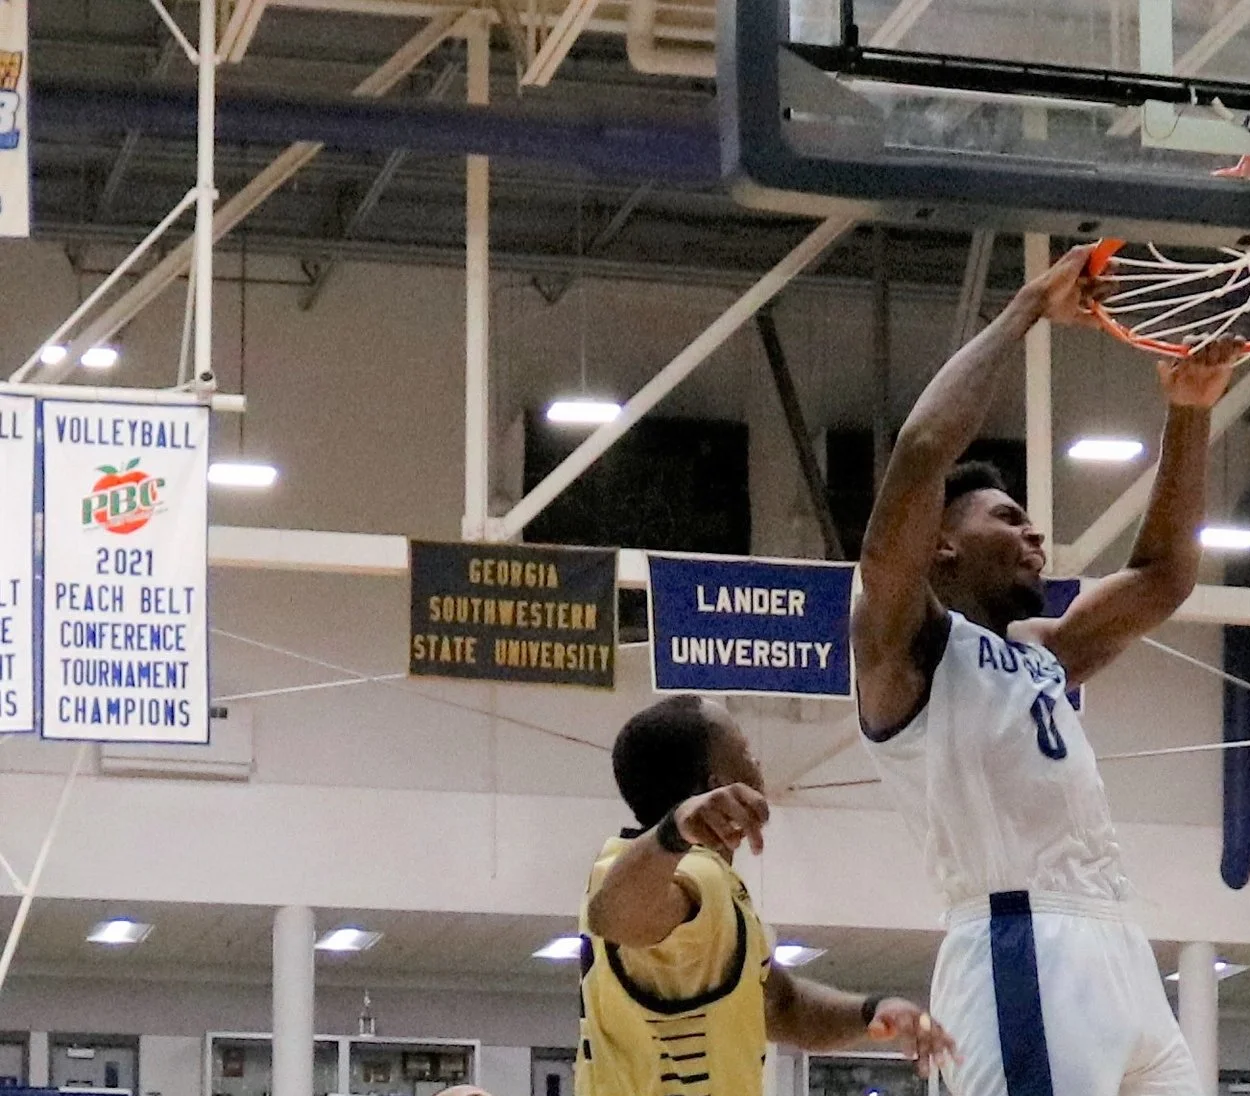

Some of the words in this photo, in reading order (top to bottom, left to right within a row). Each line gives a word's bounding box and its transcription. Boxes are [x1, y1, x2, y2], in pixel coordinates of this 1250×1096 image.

[56, 415, 197, 449] VOLLEYBALL
[81, 477, 166, 525] PBC
[96, 547, 154, 576] 2021
[468, 558, 560, 589] GEORGIA
[56, 582, 124, 613] PEACH
[140, 586, 195, 615] BELT
[429, 596, 598, 630] SOUTHWESTERN
[696, 585, 807, 617] LANDER
[60, 620, 188, 652] CONFERENCE
[413, 634, 478, 664] STATE
[494, 638, 612, 673] UNIVERSITY
[671, 636, 833, 670] UNIVERSITY
[60, 657, 190, 690] TOURNAMENT
[58, 695, 191, 728] CHAMPIONS
[1029, 690, 1068, 761] 0
